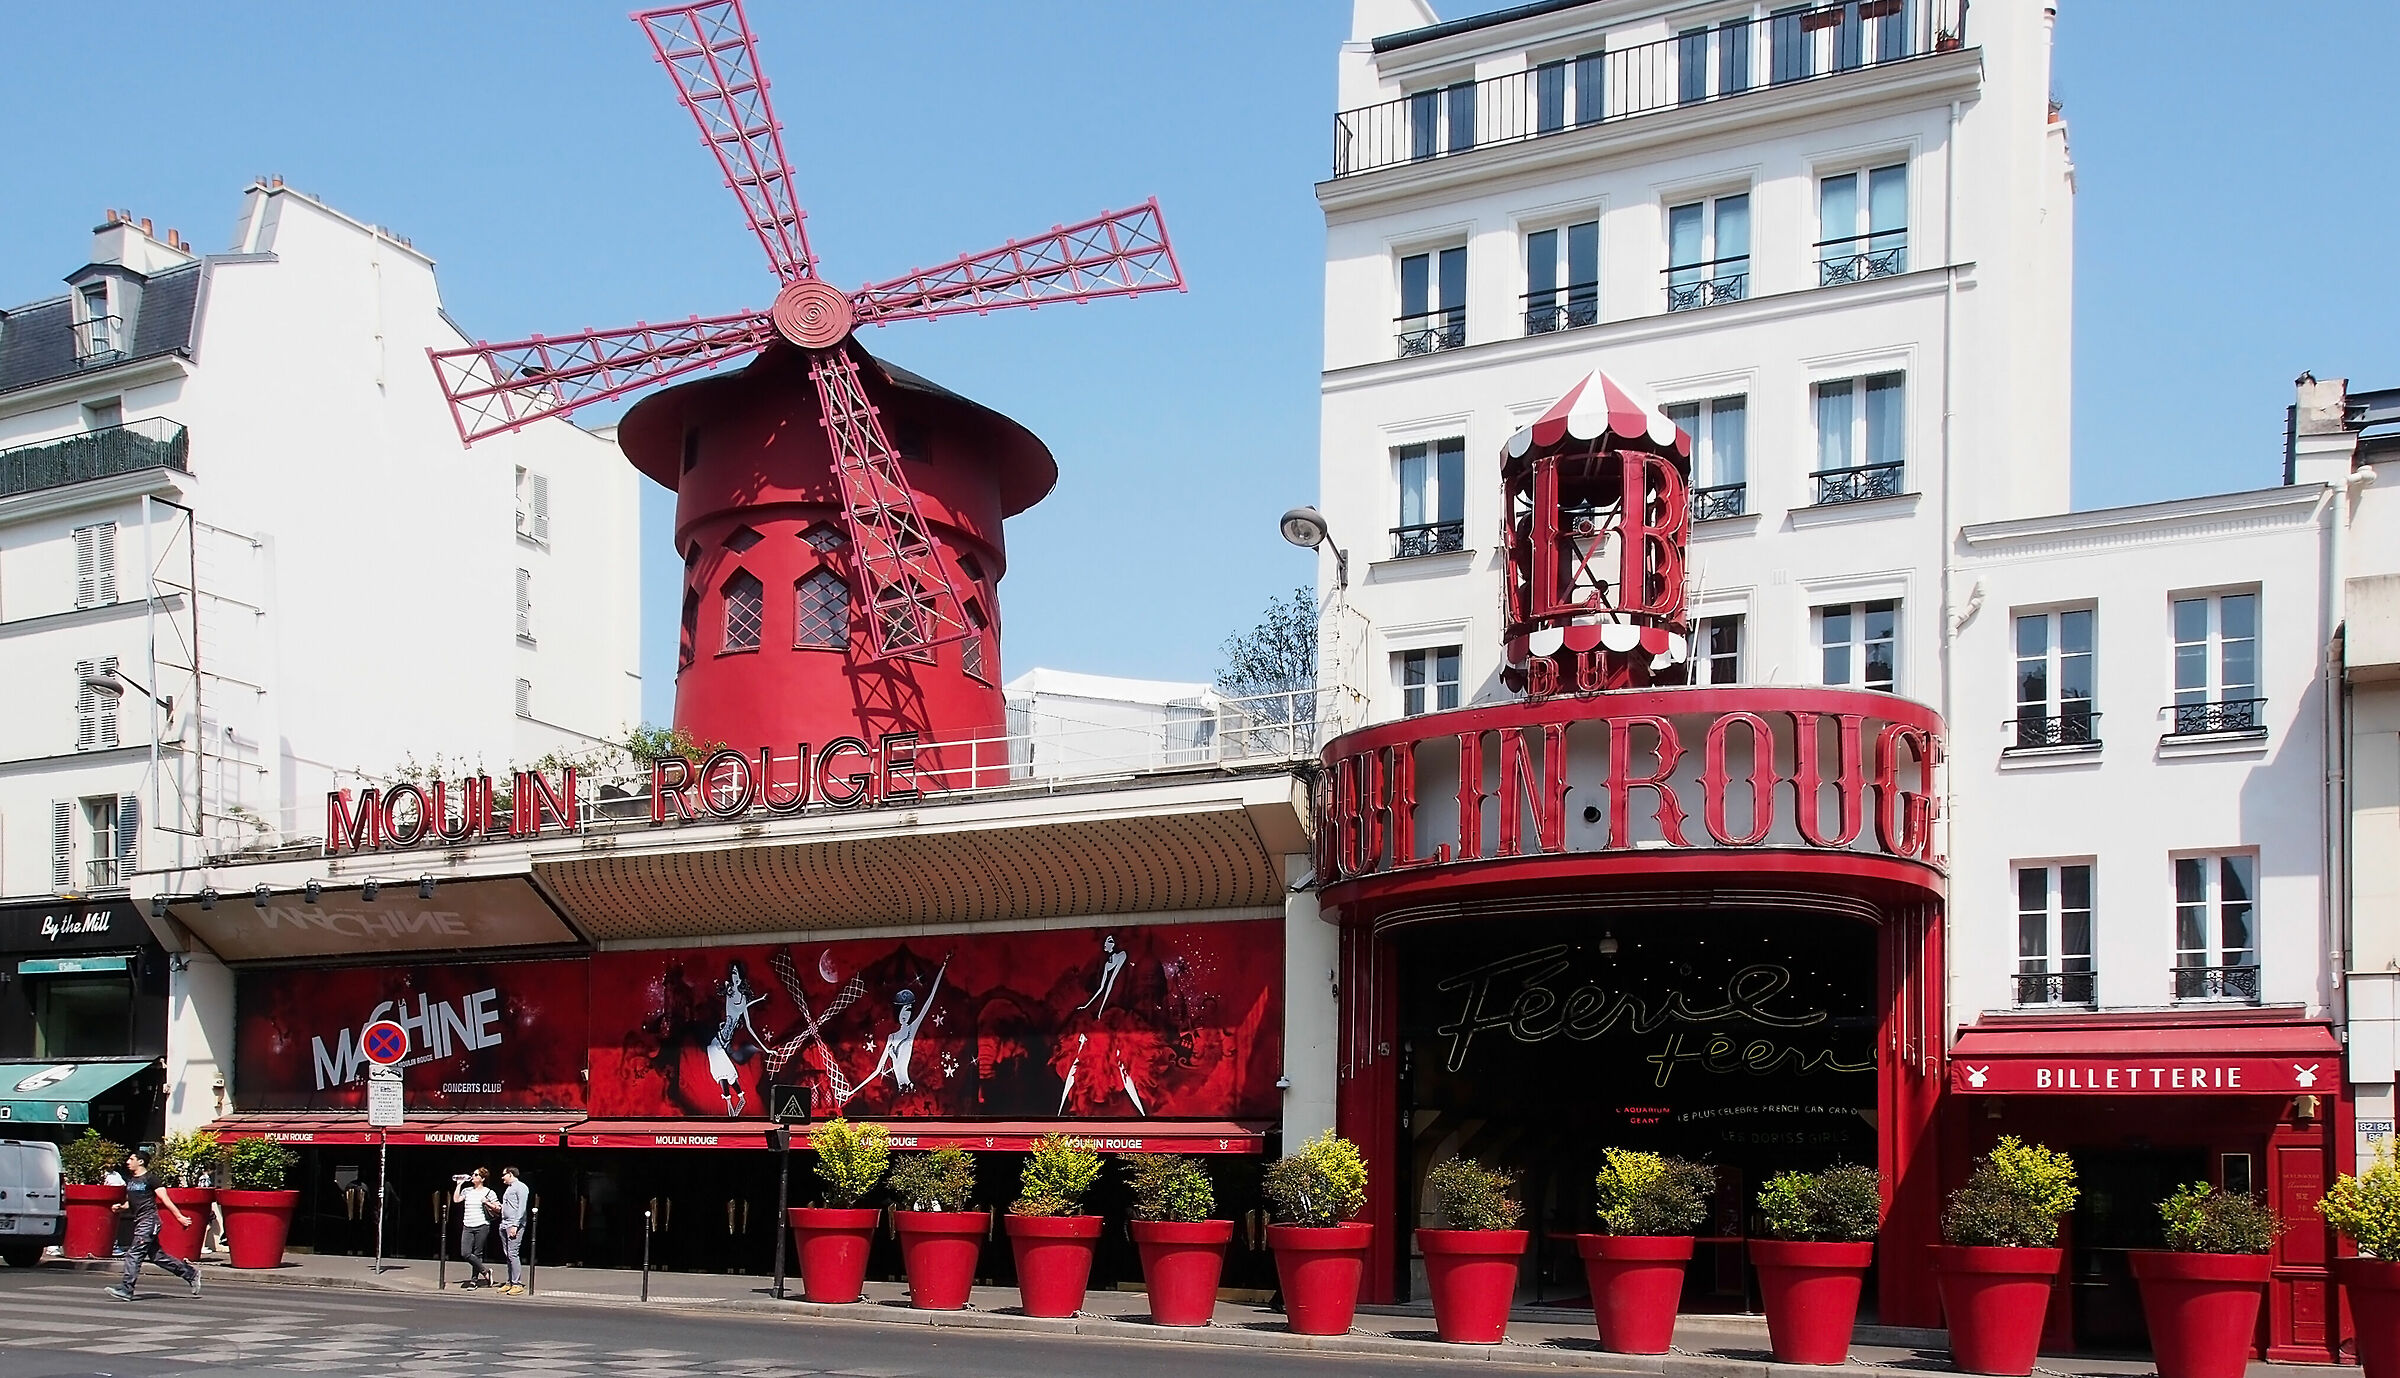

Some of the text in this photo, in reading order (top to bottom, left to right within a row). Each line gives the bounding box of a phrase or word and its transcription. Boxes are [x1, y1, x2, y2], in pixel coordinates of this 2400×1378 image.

[1526, 650, 1608, 697] DU
[327, 730, 923, 851] MOULIN ROUGE
[41, 911, 111, 941] By the Mill
[2036, 1067, 2241, 1089] BILLETTERIE
[442, 1083, 502, 1093] CONCERTS CLUB
[2359, 1122, 2391, 1131] 82 84
[264, 1132, 313, 1141] MOULIN ROUGE
[425, 1134, 480, 1143] MOULIN ROUGE
[655, 1135, 719, 1145] MOULIN ROUGE
[1105, 1139, 1143, 1149] ROUGE
